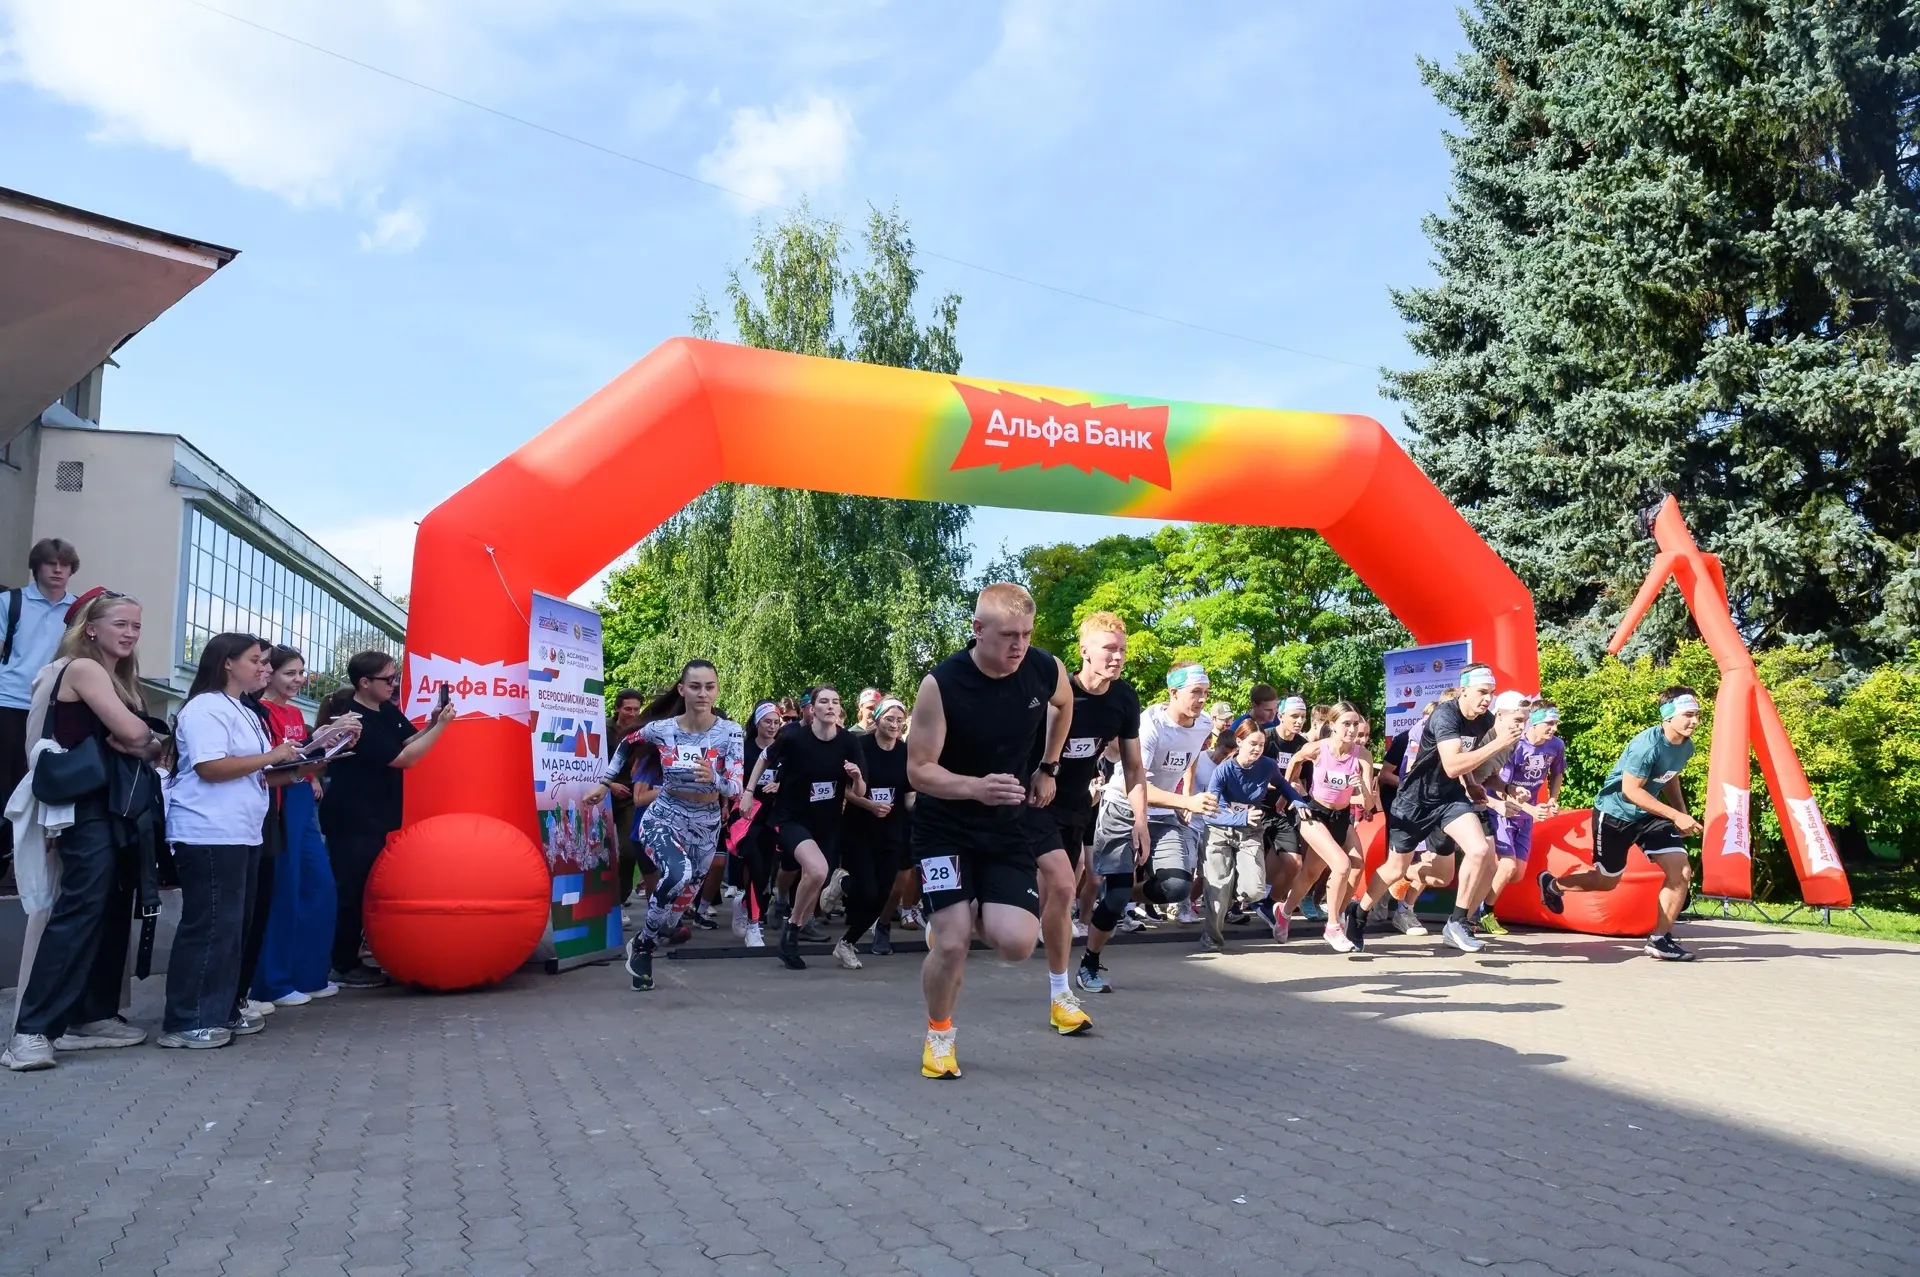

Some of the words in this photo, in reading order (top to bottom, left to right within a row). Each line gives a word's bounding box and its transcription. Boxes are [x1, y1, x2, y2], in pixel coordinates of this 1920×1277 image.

[985, 409, 1080, 447] Альфа
[1085, 420, 1153, 450] Банк
[492, 677, 530, 699] Бан
[538, 689, 585, 705] ВСЕРОССИЙСКИЙ
[1075, 744, 1091, 752] 57
[542, 758, 594, 772] МАРАФОН
[683, 752, 698, 764] 96
[1169, 757, 1185, 767] 123
[1331, 777, 1343, 785] 60
[817, 787, 830, 795] 95
[875, 793, 889, 801] 132
[1734, 793, 1744, 816] Банк
[1804, 804, 1818, 829] Банк
[1734, 817, 1746, 848] Альфа
[1813, 830, 1834, 862] Альфа
[930, 866, 950, 881] 28
